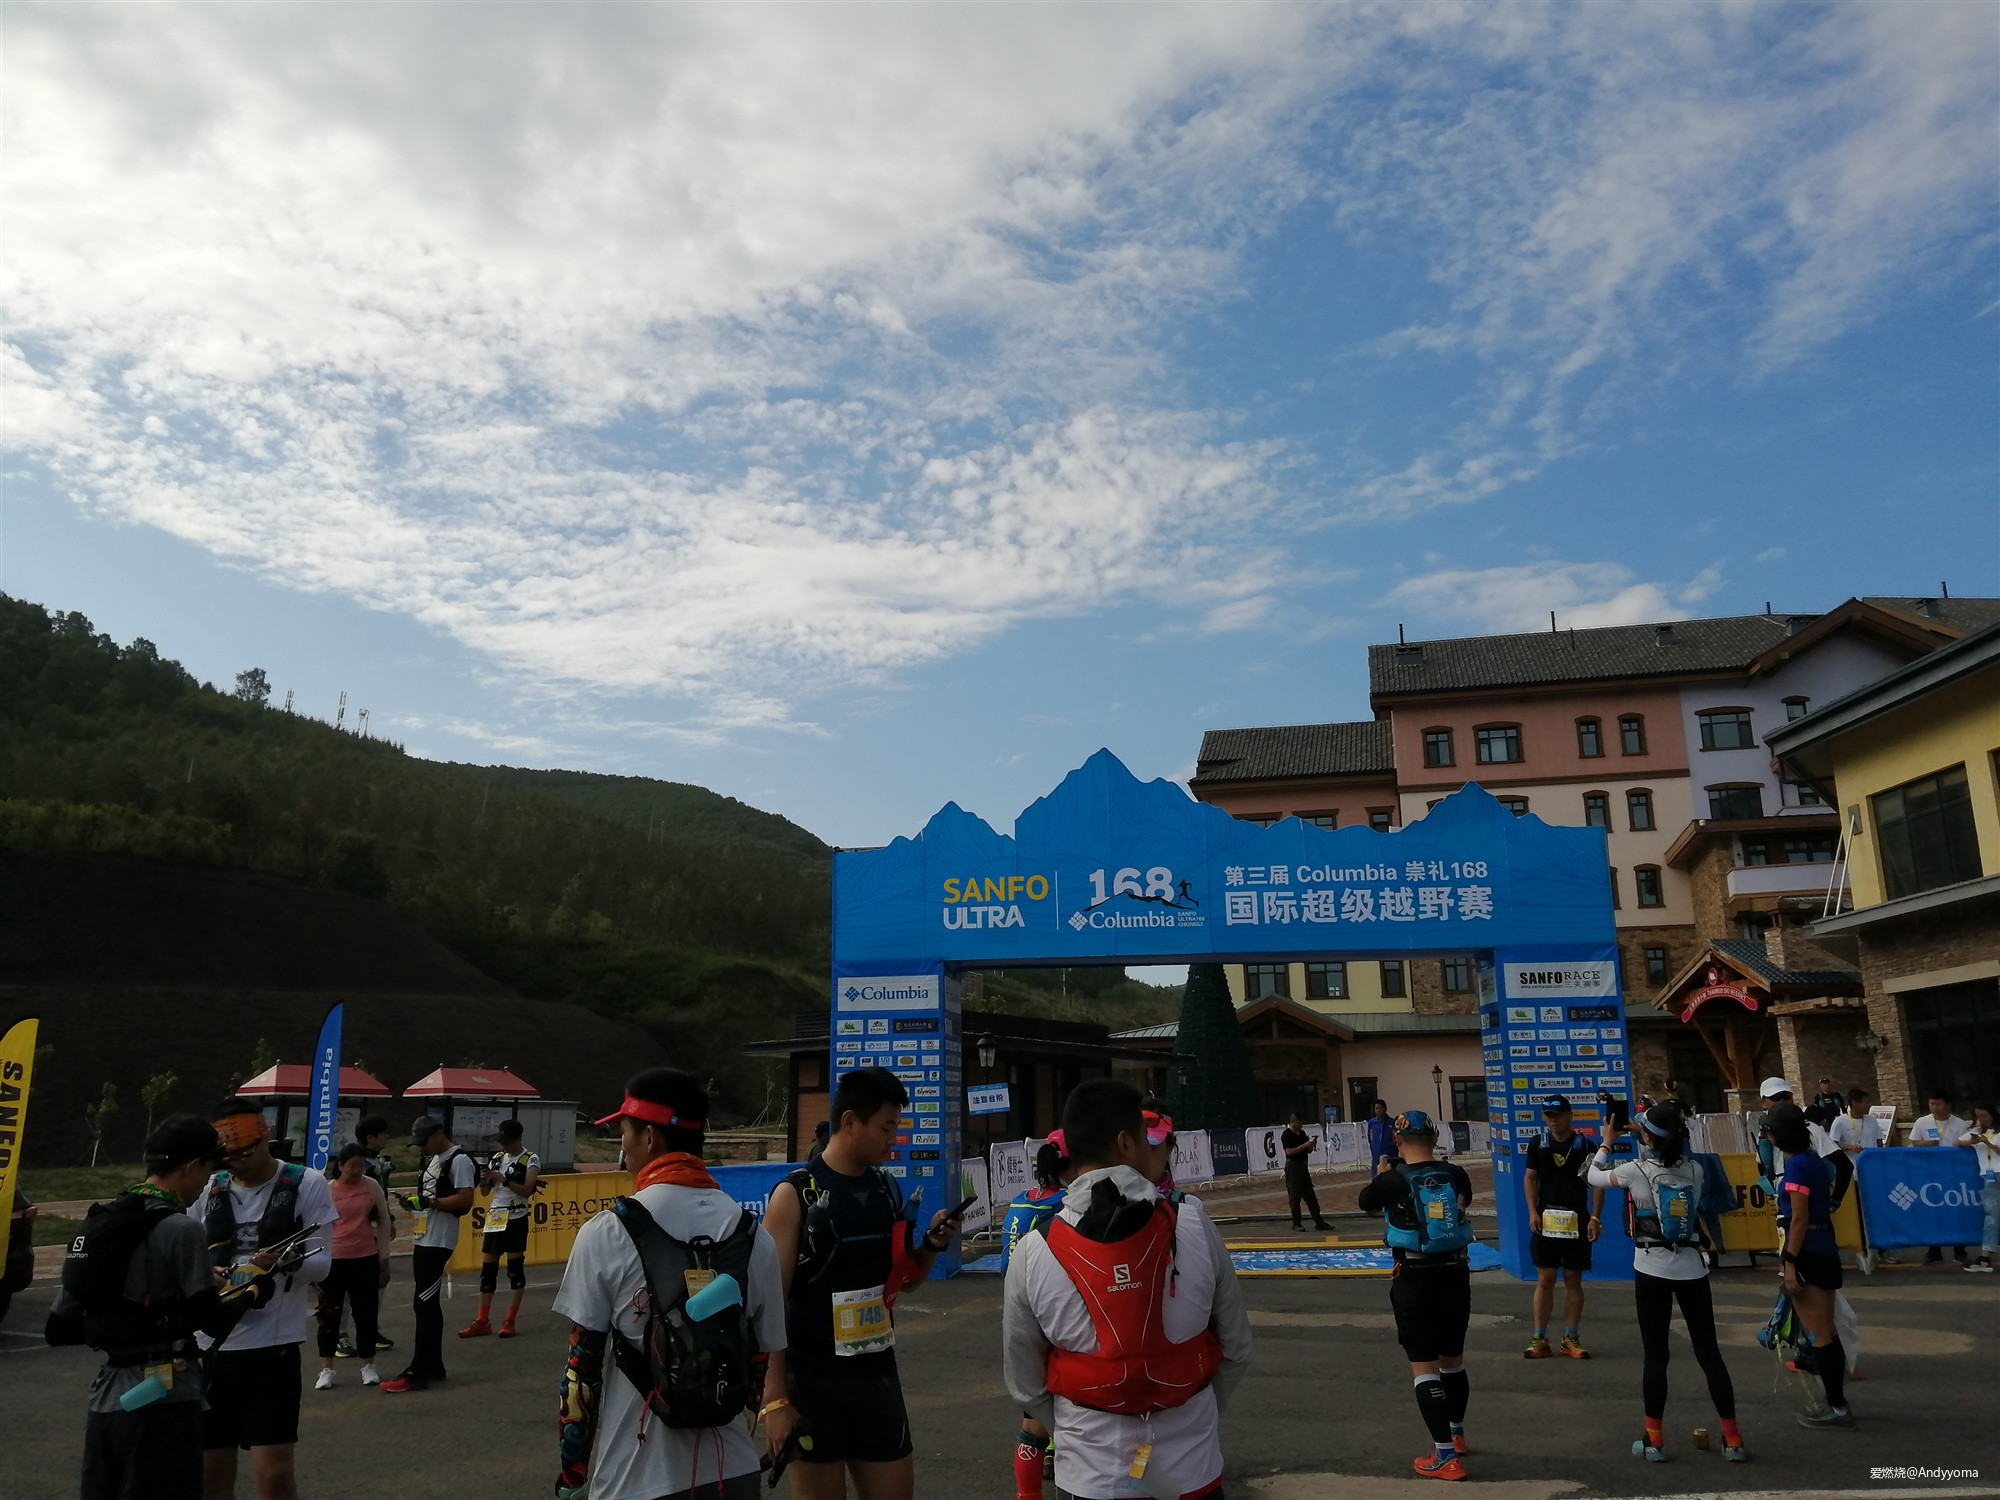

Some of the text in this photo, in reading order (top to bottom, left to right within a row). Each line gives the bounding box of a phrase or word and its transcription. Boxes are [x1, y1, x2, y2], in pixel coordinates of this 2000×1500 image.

[1089, 867, 1175, 906] 168
[1224, 860, 1488, 887] 第三届 Columbia 崇礼168
[943, 875, 1049, 904] SANFO
[943, 905, 1025, 930] ULTRA
[1224, 884, 1494, 926] 国际超级越野赛
[1088, 911, 1175, 929] Columbia
[1519, 970, 1601, 985] SANFO RACE
[860, 986, 929, 1001] Columbia
[312, 1047, 334, 1176] Columbia
